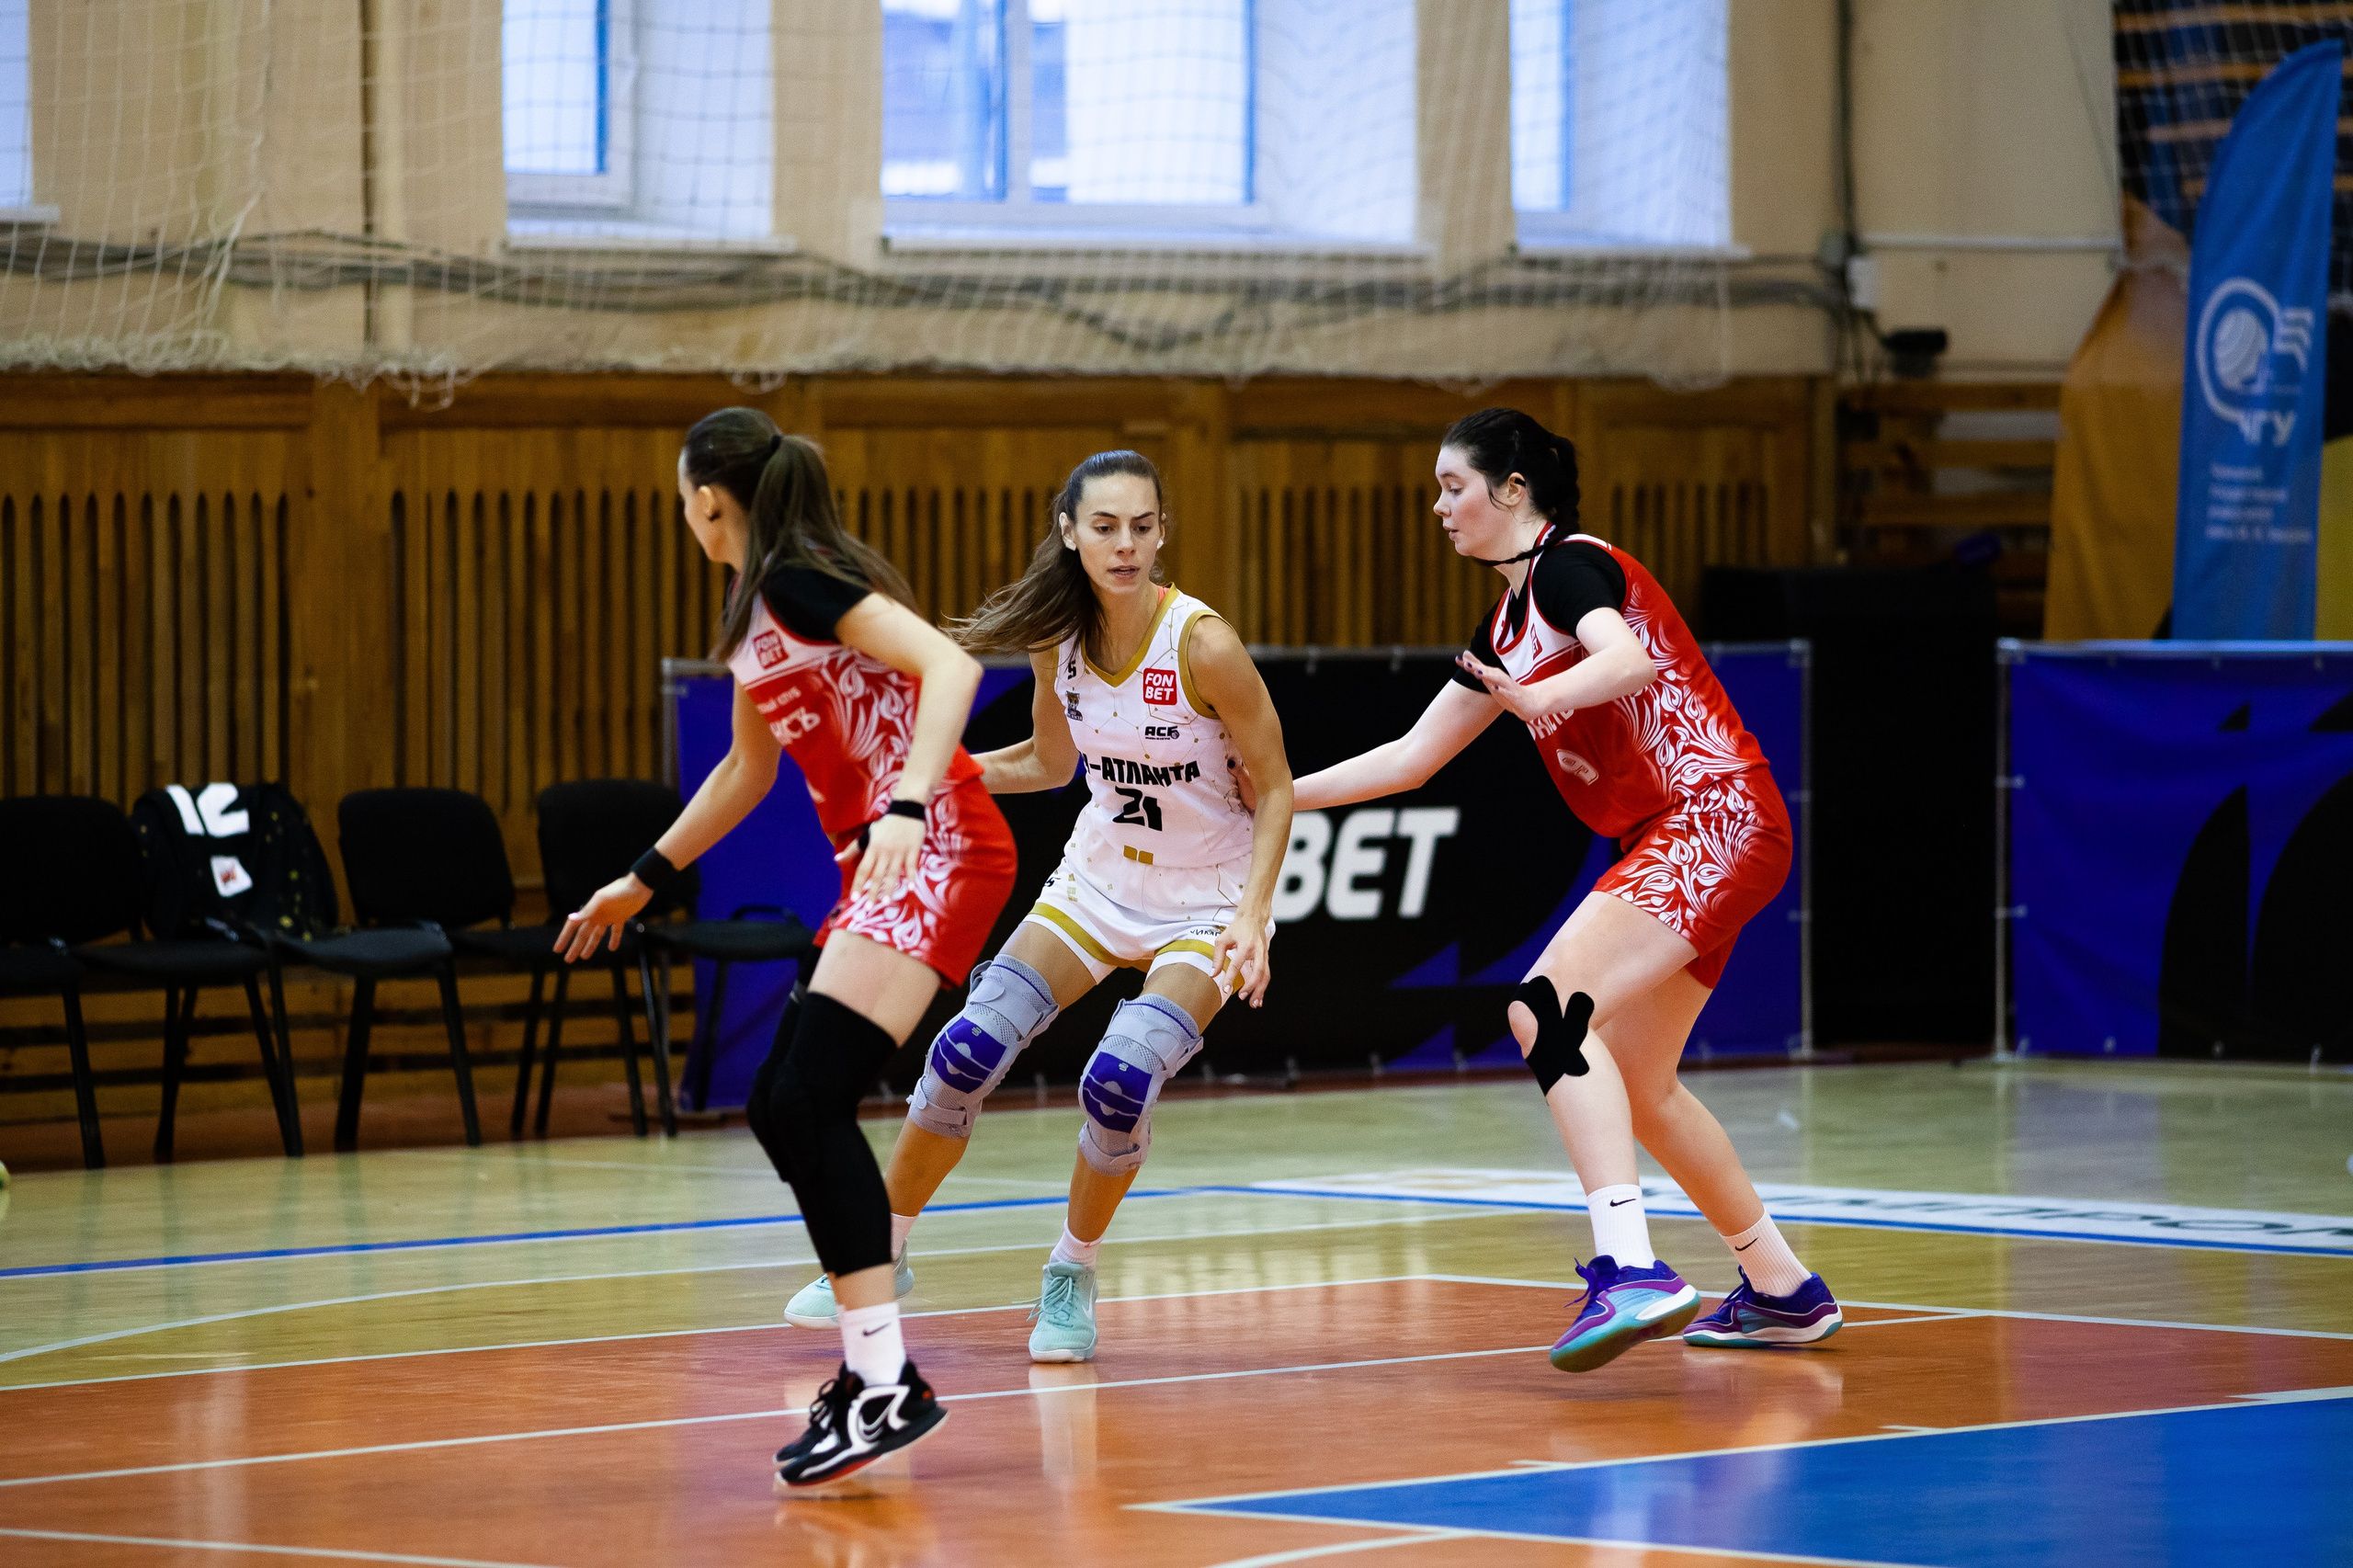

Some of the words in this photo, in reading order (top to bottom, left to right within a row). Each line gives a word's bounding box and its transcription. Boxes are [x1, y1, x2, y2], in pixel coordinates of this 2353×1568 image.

[1145, 672, 1175, 687] FON
[1145, 686, 1175, 701] BET
[1112, 785, 1164, 832] 21
[1271, 805, 1461, 923] BET
